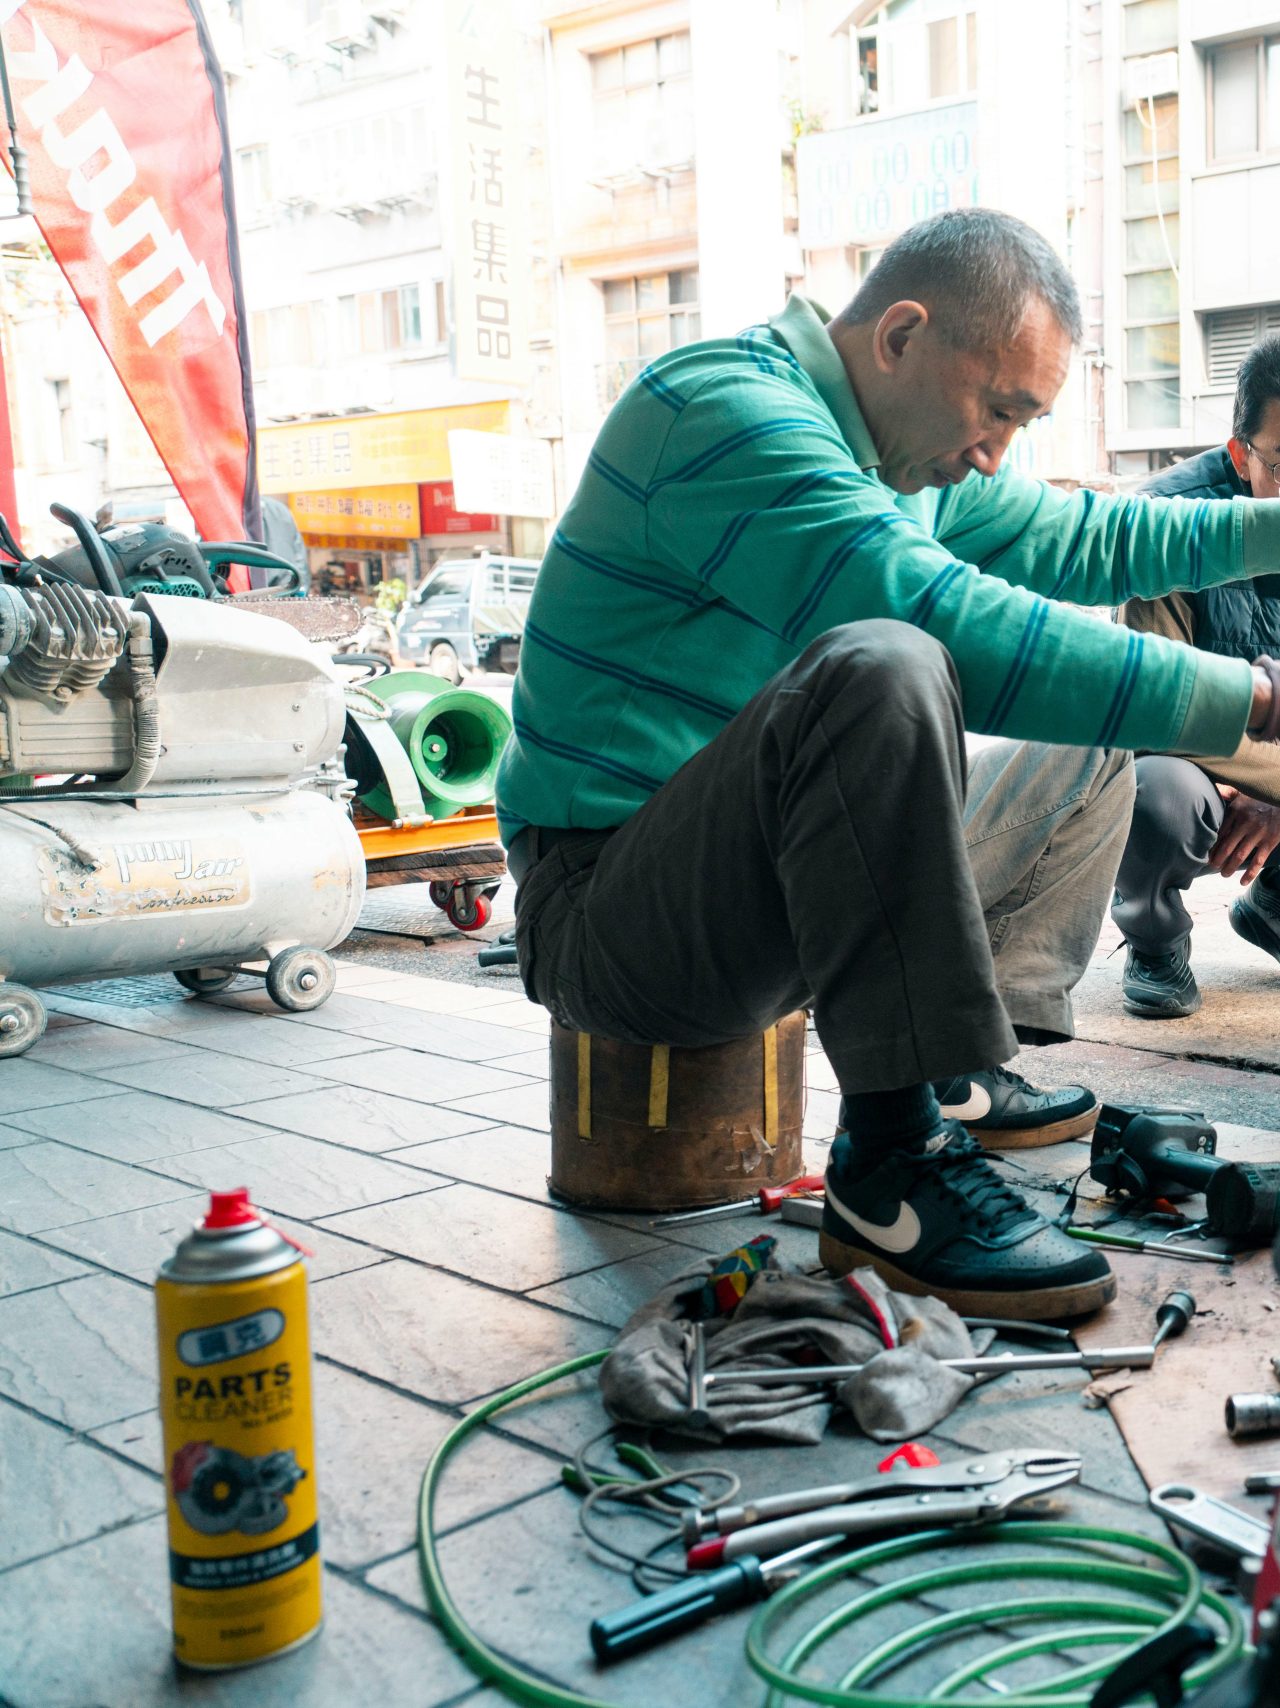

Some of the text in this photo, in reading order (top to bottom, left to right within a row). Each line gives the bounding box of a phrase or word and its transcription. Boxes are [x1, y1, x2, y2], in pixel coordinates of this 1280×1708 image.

[464, 63, 511, 360] 生活集品
[175, 1362, 292, 1400] PARTS
